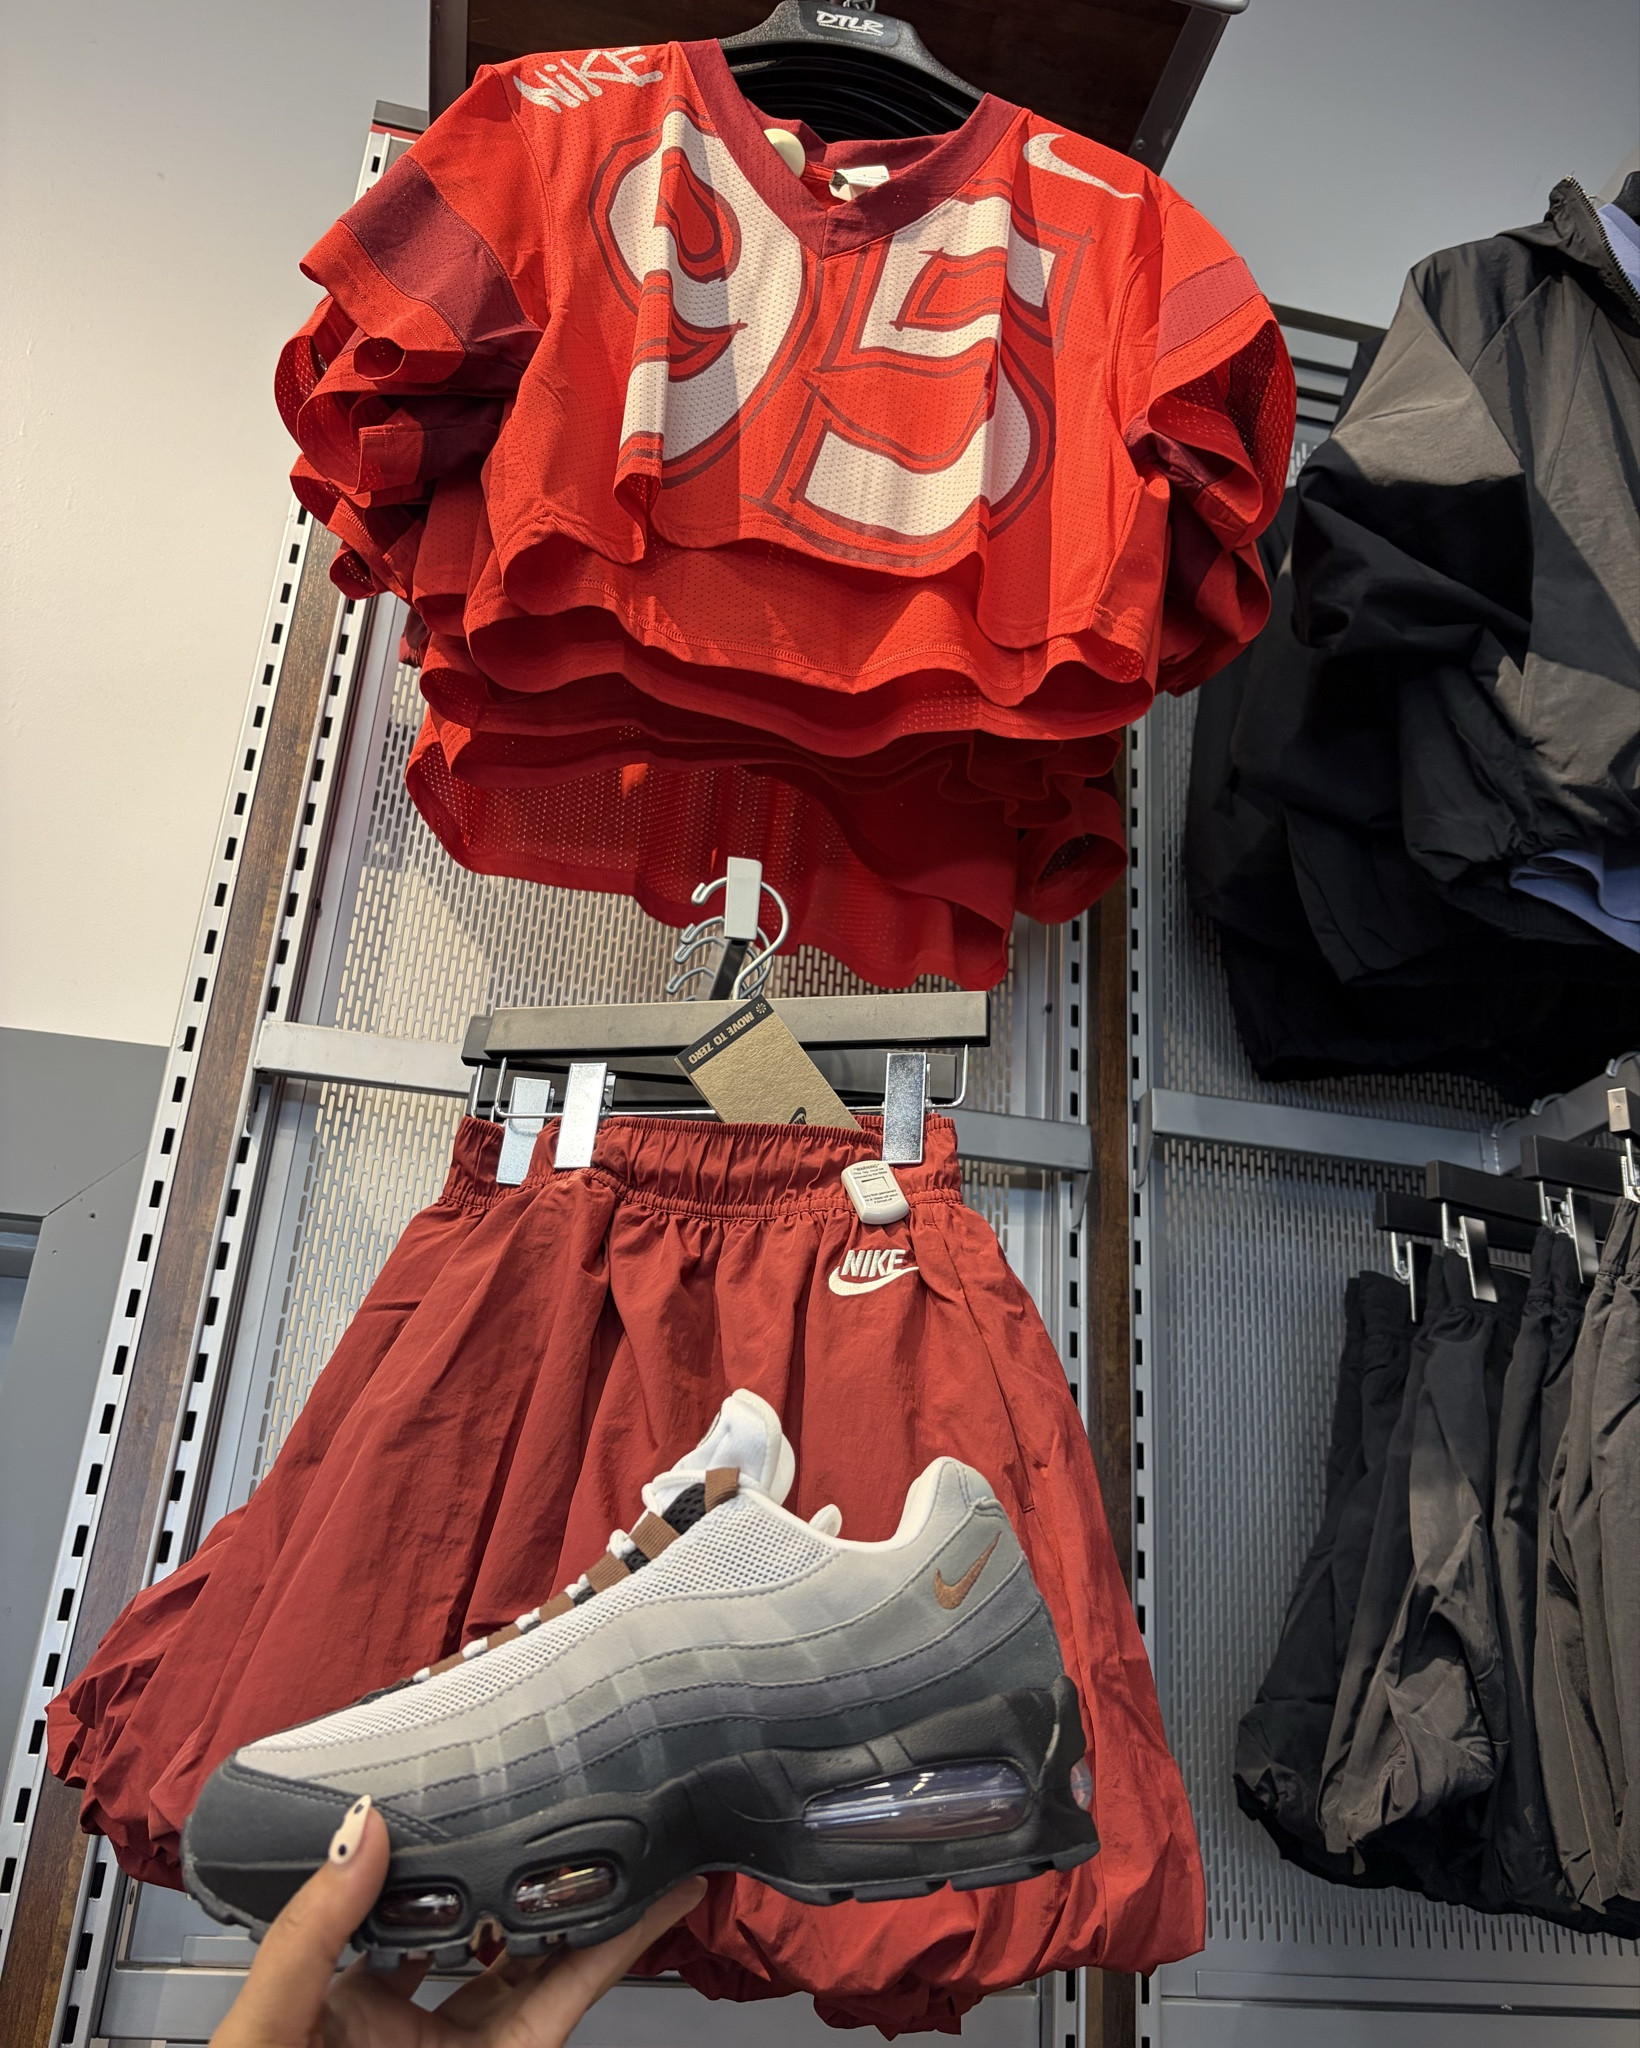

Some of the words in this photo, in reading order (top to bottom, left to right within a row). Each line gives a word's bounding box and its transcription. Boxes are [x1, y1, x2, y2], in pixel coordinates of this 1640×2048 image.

[816, 10, 884, 35] DTLR
[590, 97, 1094, 568] 95
[725, 1011, 755, 1036] MOVE
[712, 1032, 728, 1046] TO
[688, 1042, 714, 1065] ZERO
[841, 1248, 906, 1278] NIKE
